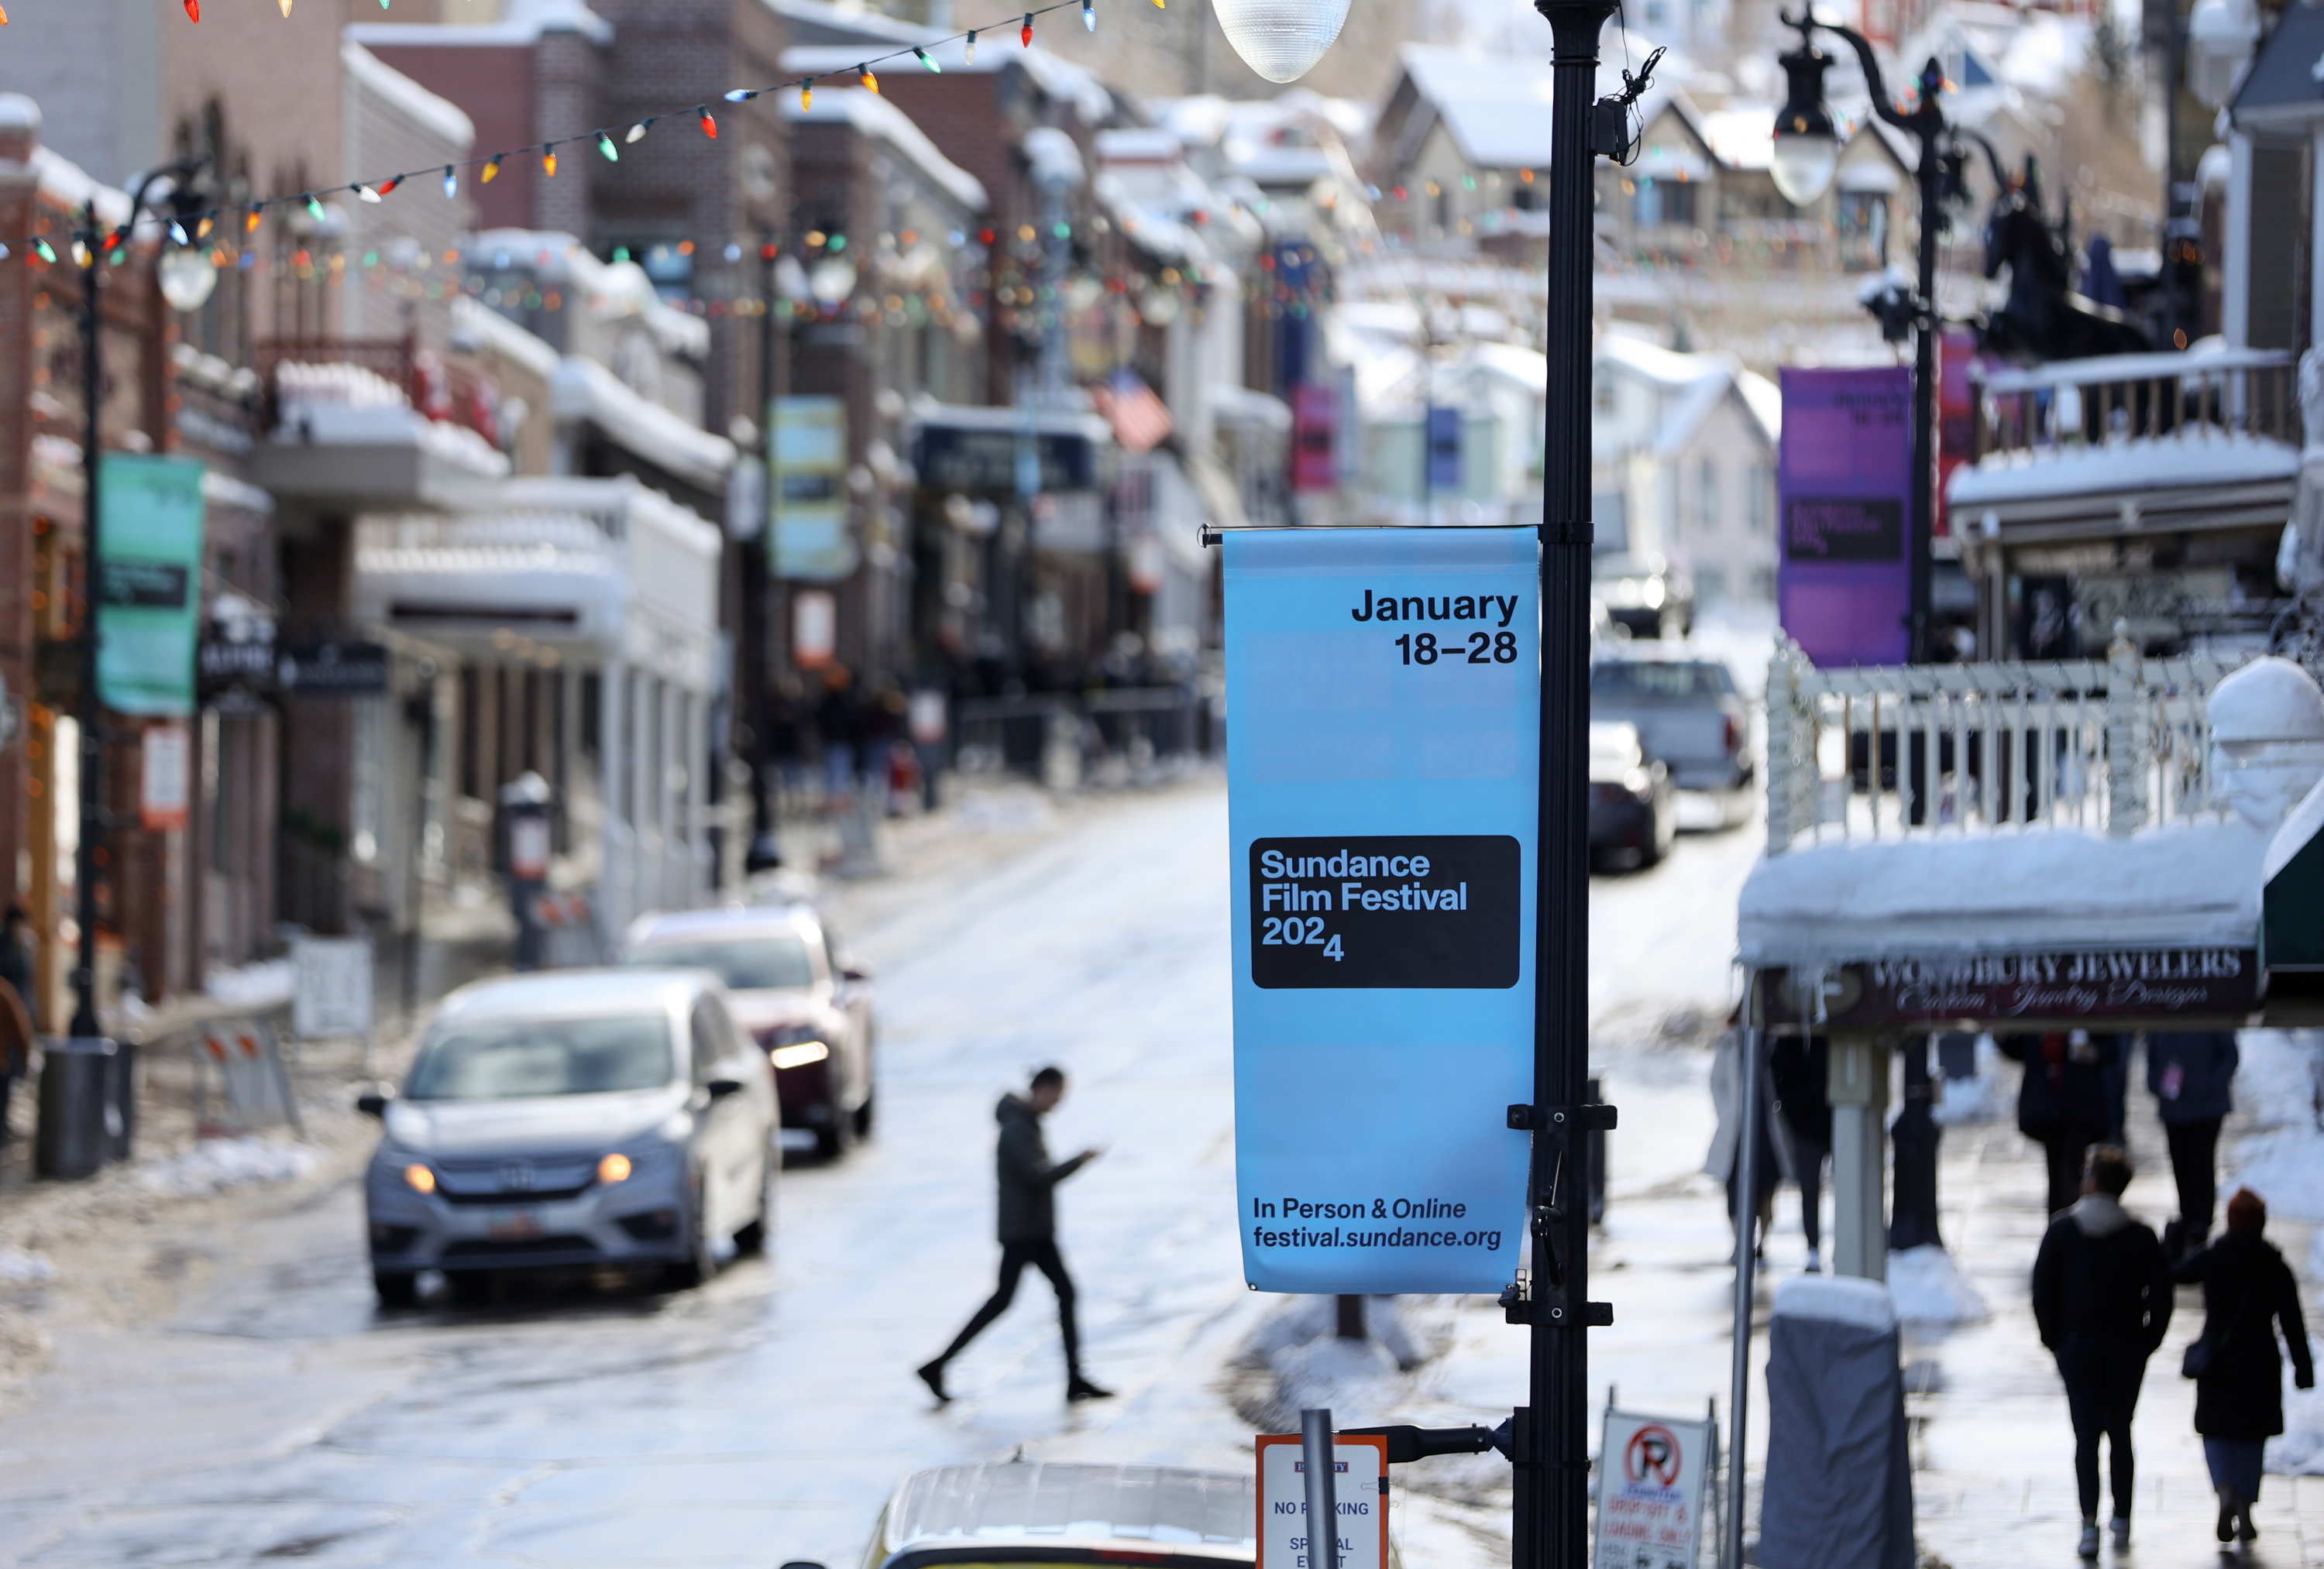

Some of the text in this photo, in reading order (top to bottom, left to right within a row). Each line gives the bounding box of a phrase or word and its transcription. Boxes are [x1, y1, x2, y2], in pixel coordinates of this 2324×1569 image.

[1351, 589, 1518, 628] January
[1394, 631, 1518, 665] 18–28
[1260, 849, 1431, 879] Sundance
[1262, 881, 1468, 912] Film Festival
[1261, 916, 1345, 962] 2024
[2068, 948, 2241, 982] JEWELERS
[1989, 981, 2099, 1017] Jewelry
[2106, 978, 2209, 1011] Designs
[1253, 1197, 1466, 1219] In Person & Online
[1253, 1226, 1501, 1251] festival.sundance.org
[1274, 1502, 1369, 1516] NO PKING
[1290, 1537, 1354, 1550] SPAL
